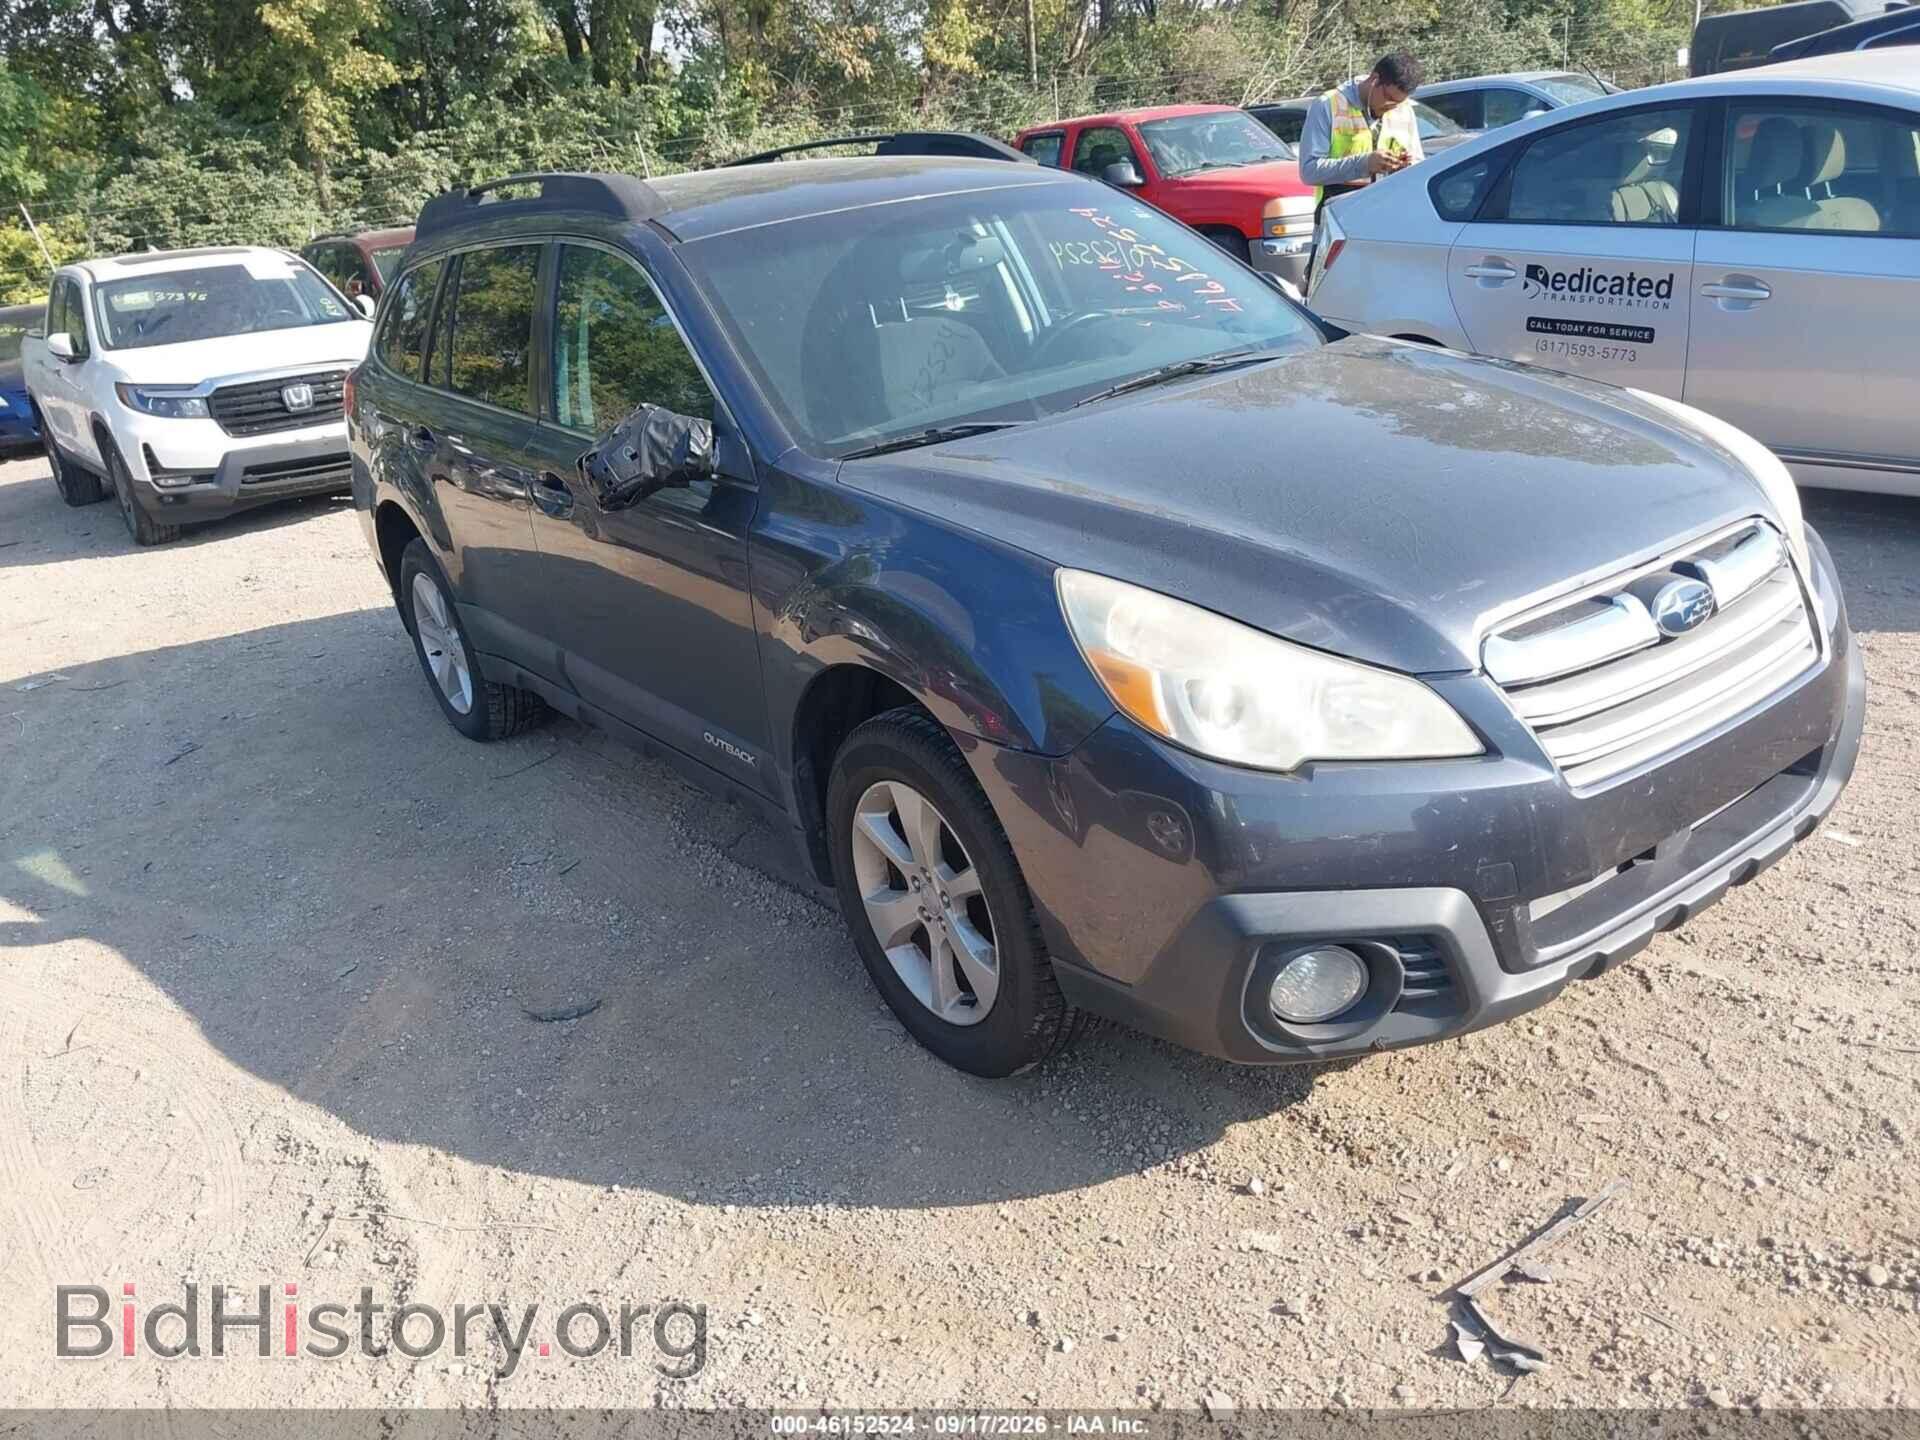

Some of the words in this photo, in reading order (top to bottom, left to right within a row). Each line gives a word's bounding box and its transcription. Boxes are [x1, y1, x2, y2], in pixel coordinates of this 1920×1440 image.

[1523, 264, 1675, 300] Dedicated
[1543, 292, 1671, 310] TRANSPORTATION
[1529, 320, 1553, 331] CALL
[1555, 322, 1585, 333] TODAY
[1587, 325, 1607, 335] FOR
[1609, 327, 1651, 340] SERVICE
[1535, 338, 1637, 362] (317)593-5773
[704, 731, 757, 767] OUTBACK
